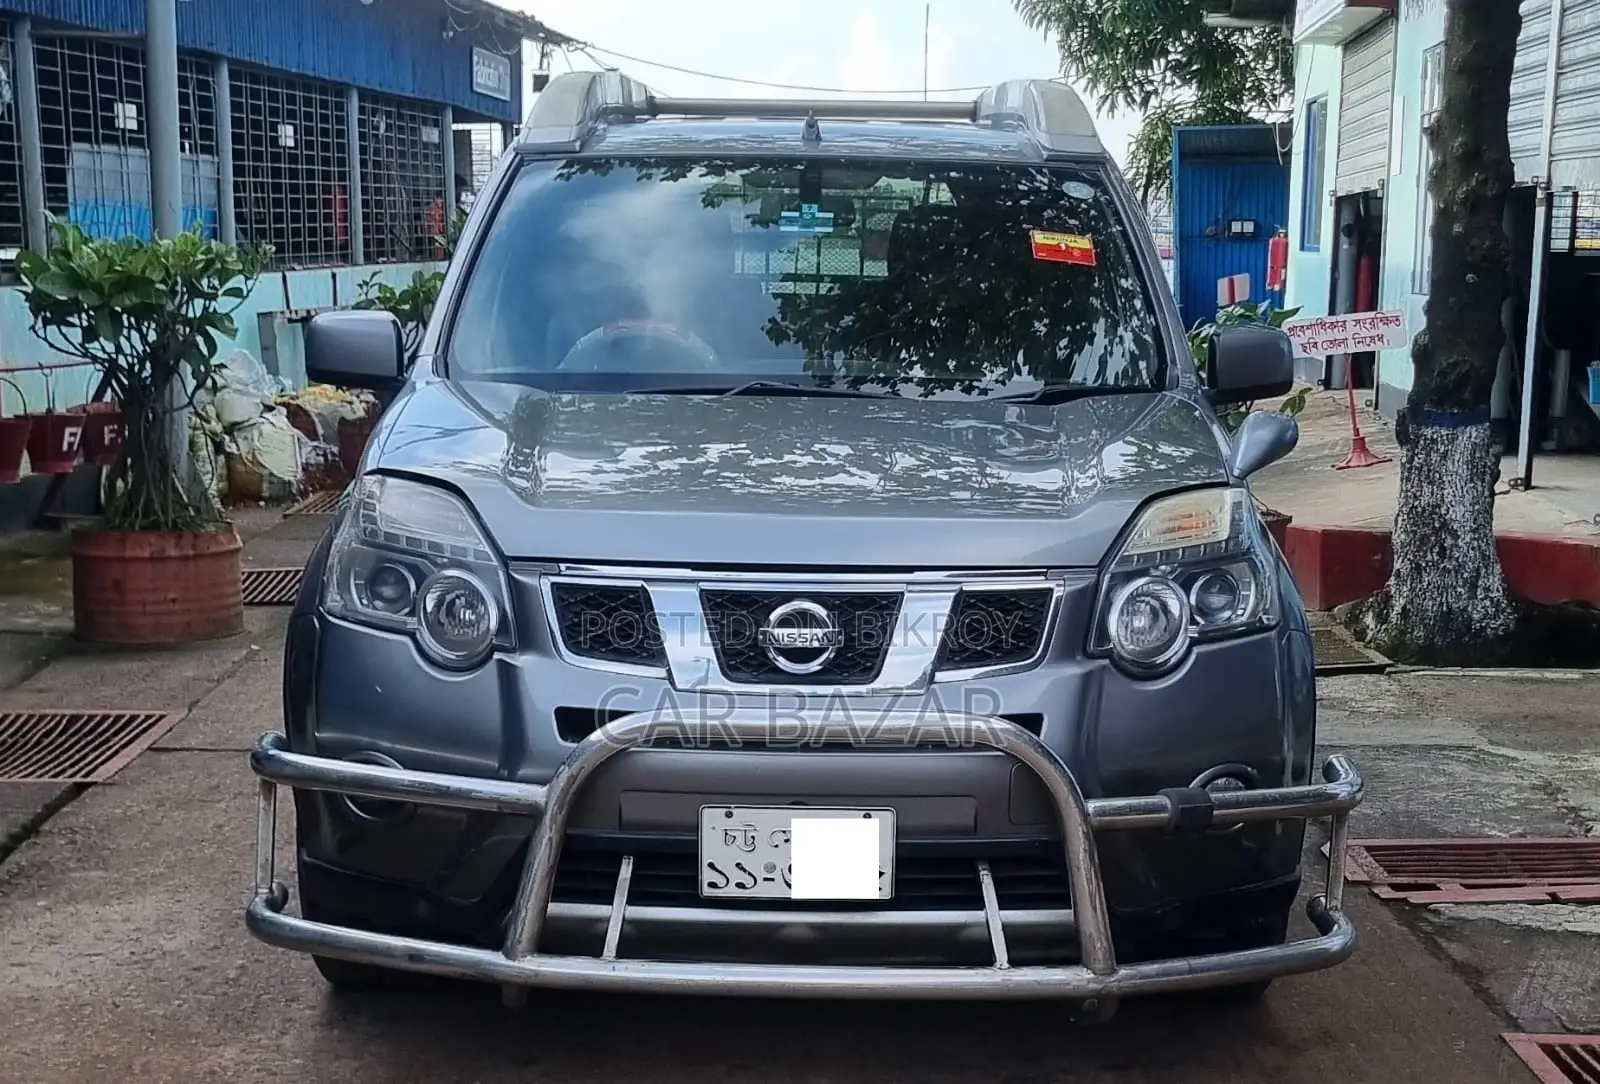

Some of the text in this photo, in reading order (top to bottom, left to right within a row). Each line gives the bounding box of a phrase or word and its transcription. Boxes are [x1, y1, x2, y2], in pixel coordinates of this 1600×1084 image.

[1287, 311, 1401, 339] প্রবেশাধিকার সংরক্ষিত
[1300, 336, 1319, 355] ছবি
[1321, 337, 1348, 351] তোলা
[766, 632, 836, 645] NISSAN
